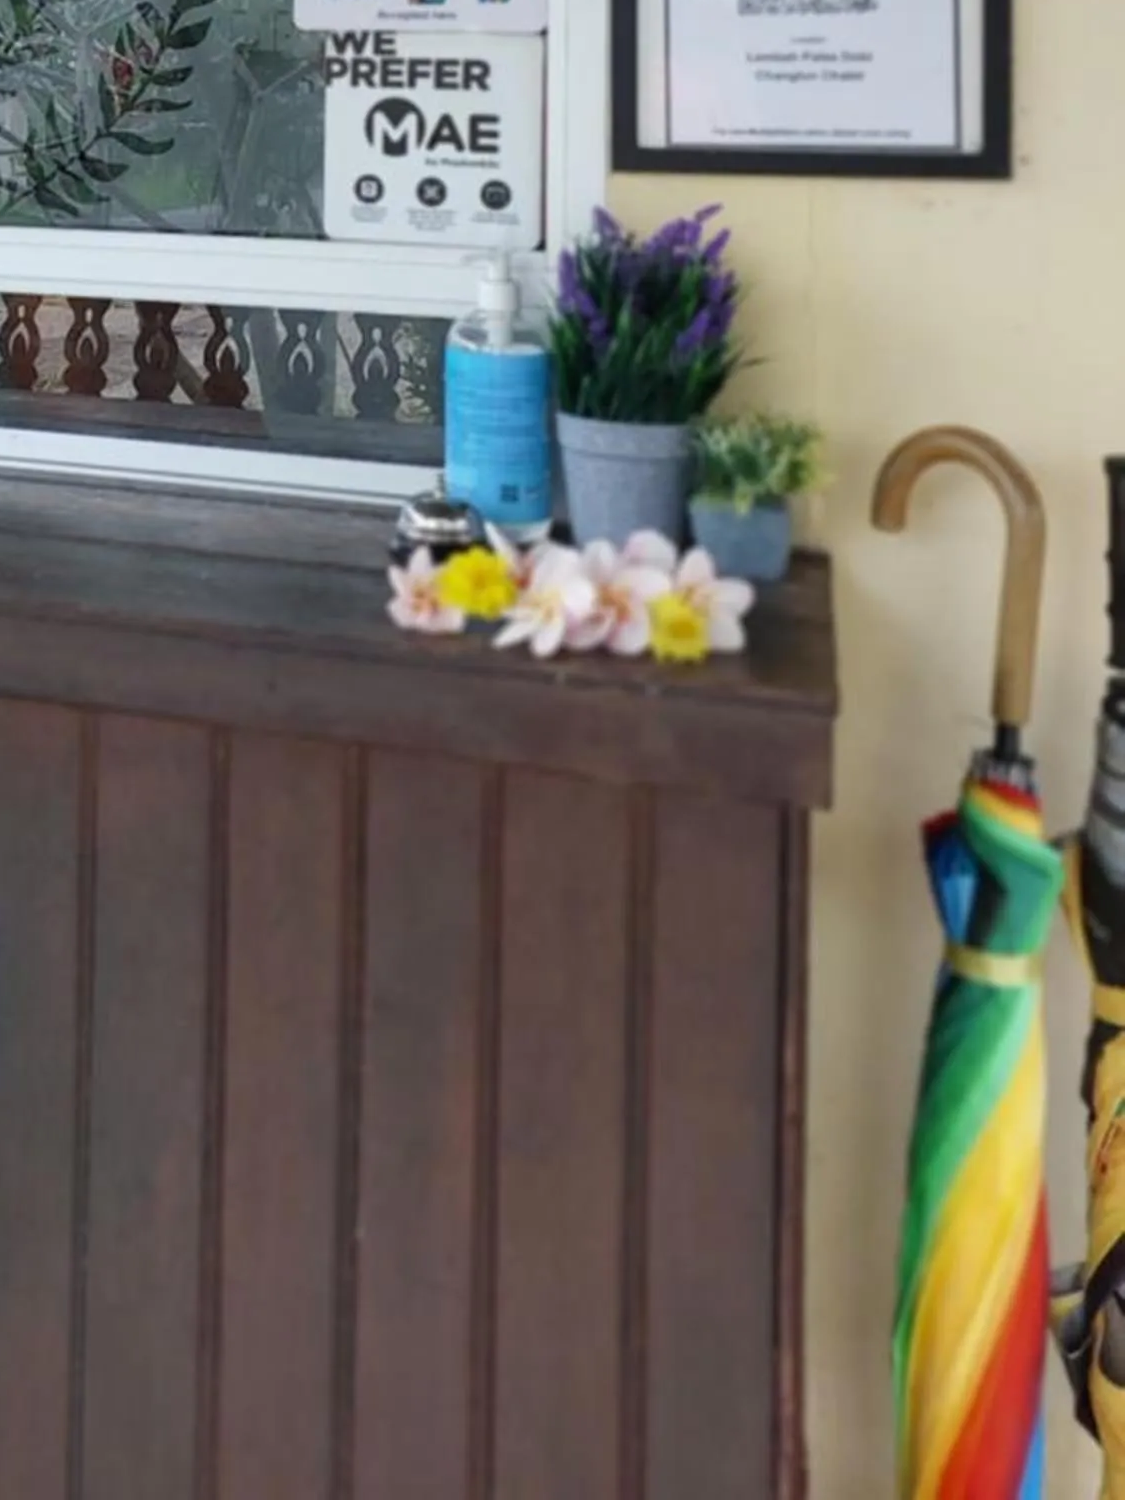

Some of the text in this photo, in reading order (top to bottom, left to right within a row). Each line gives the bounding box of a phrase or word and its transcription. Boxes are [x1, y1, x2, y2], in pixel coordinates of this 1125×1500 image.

[331, 30, 397, 56] WE
[325, 57, 491, 91] PREFER
[365, 97, 501, 157] MAE
